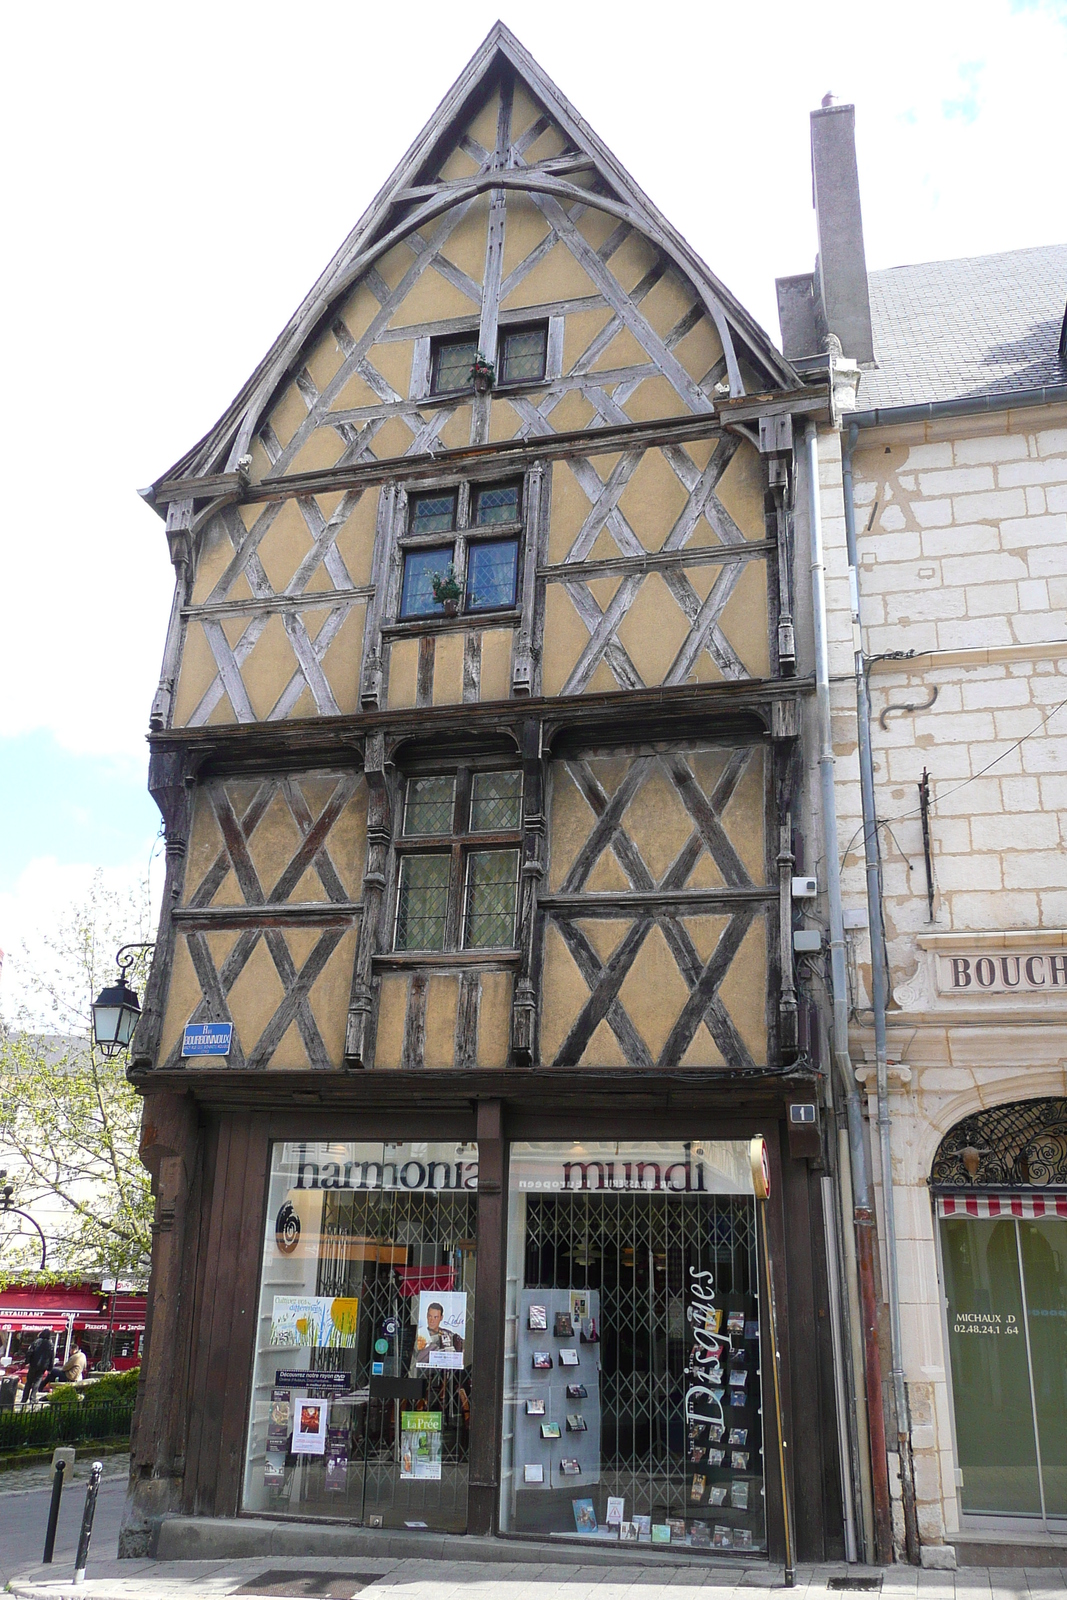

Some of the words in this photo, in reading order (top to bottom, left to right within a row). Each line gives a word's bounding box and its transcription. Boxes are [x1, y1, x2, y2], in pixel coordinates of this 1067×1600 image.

[950, 955, 1067, 988] BOUCH
[184, 1034, 230, 1045] BOURBONNOUX
[799, 1106, 805, 1121] 1
[293, 1143, 479, 1190] harmonia
[560, 1141, 709, 1193] mundi
[956, 1313, 1002, 1323] MICHAUX
[683, 1265, 736, 1434] Disques
[407, 1420, 417, 1429] La
[417, 1418, 439, 1430] Prée
